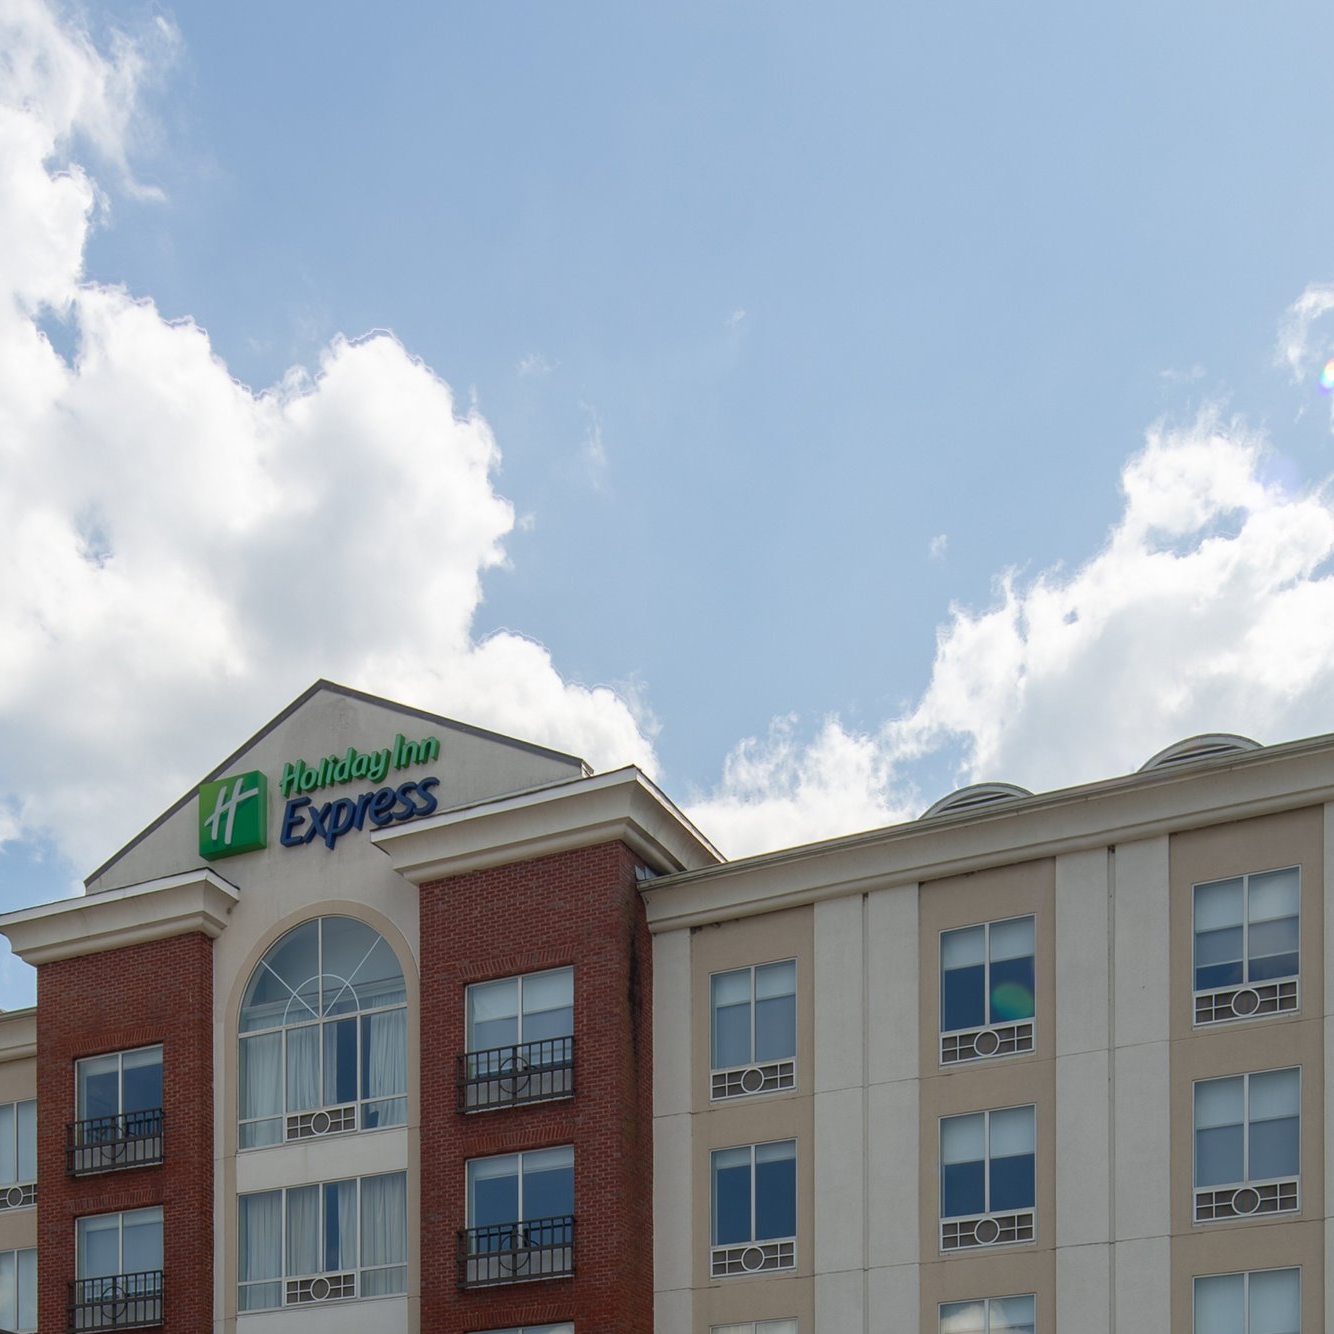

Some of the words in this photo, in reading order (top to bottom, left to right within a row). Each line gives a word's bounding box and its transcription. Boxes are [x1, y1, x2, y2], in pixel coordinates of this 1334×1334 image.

[280, 747, 391, 798] Holiday
[394, 734, 440, 769] Inn
[280, 777, 440, 850] Express
